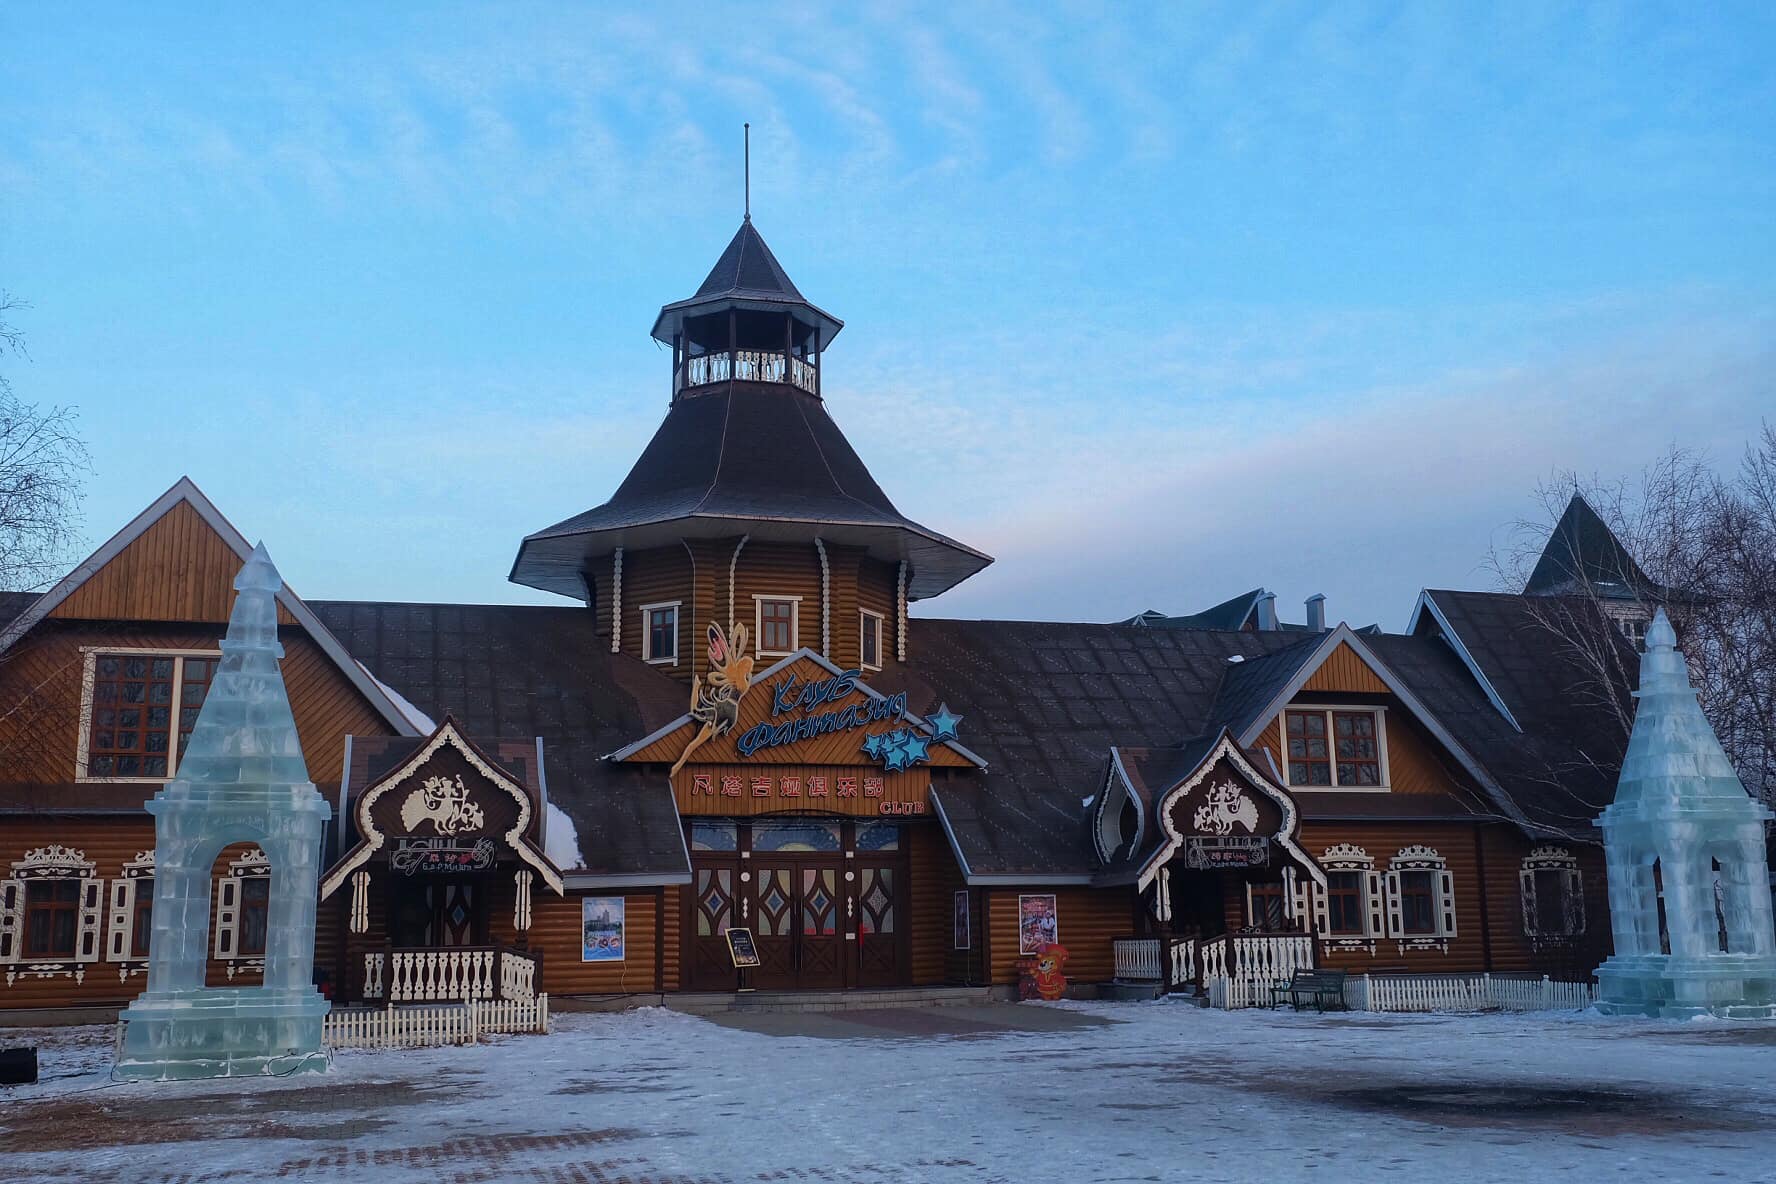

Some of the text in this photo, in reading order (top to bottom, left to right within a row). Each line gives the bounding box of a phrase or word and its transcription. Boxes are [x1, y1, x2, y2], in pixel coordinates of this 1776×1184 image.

[772, 669, 862, 717] Клуб
[738, 691, 907, 757] Фантазия
[692, 774, 884, 798] 凡塔吉娅俱乐部
[879, 801, 926, 816] CLUB
